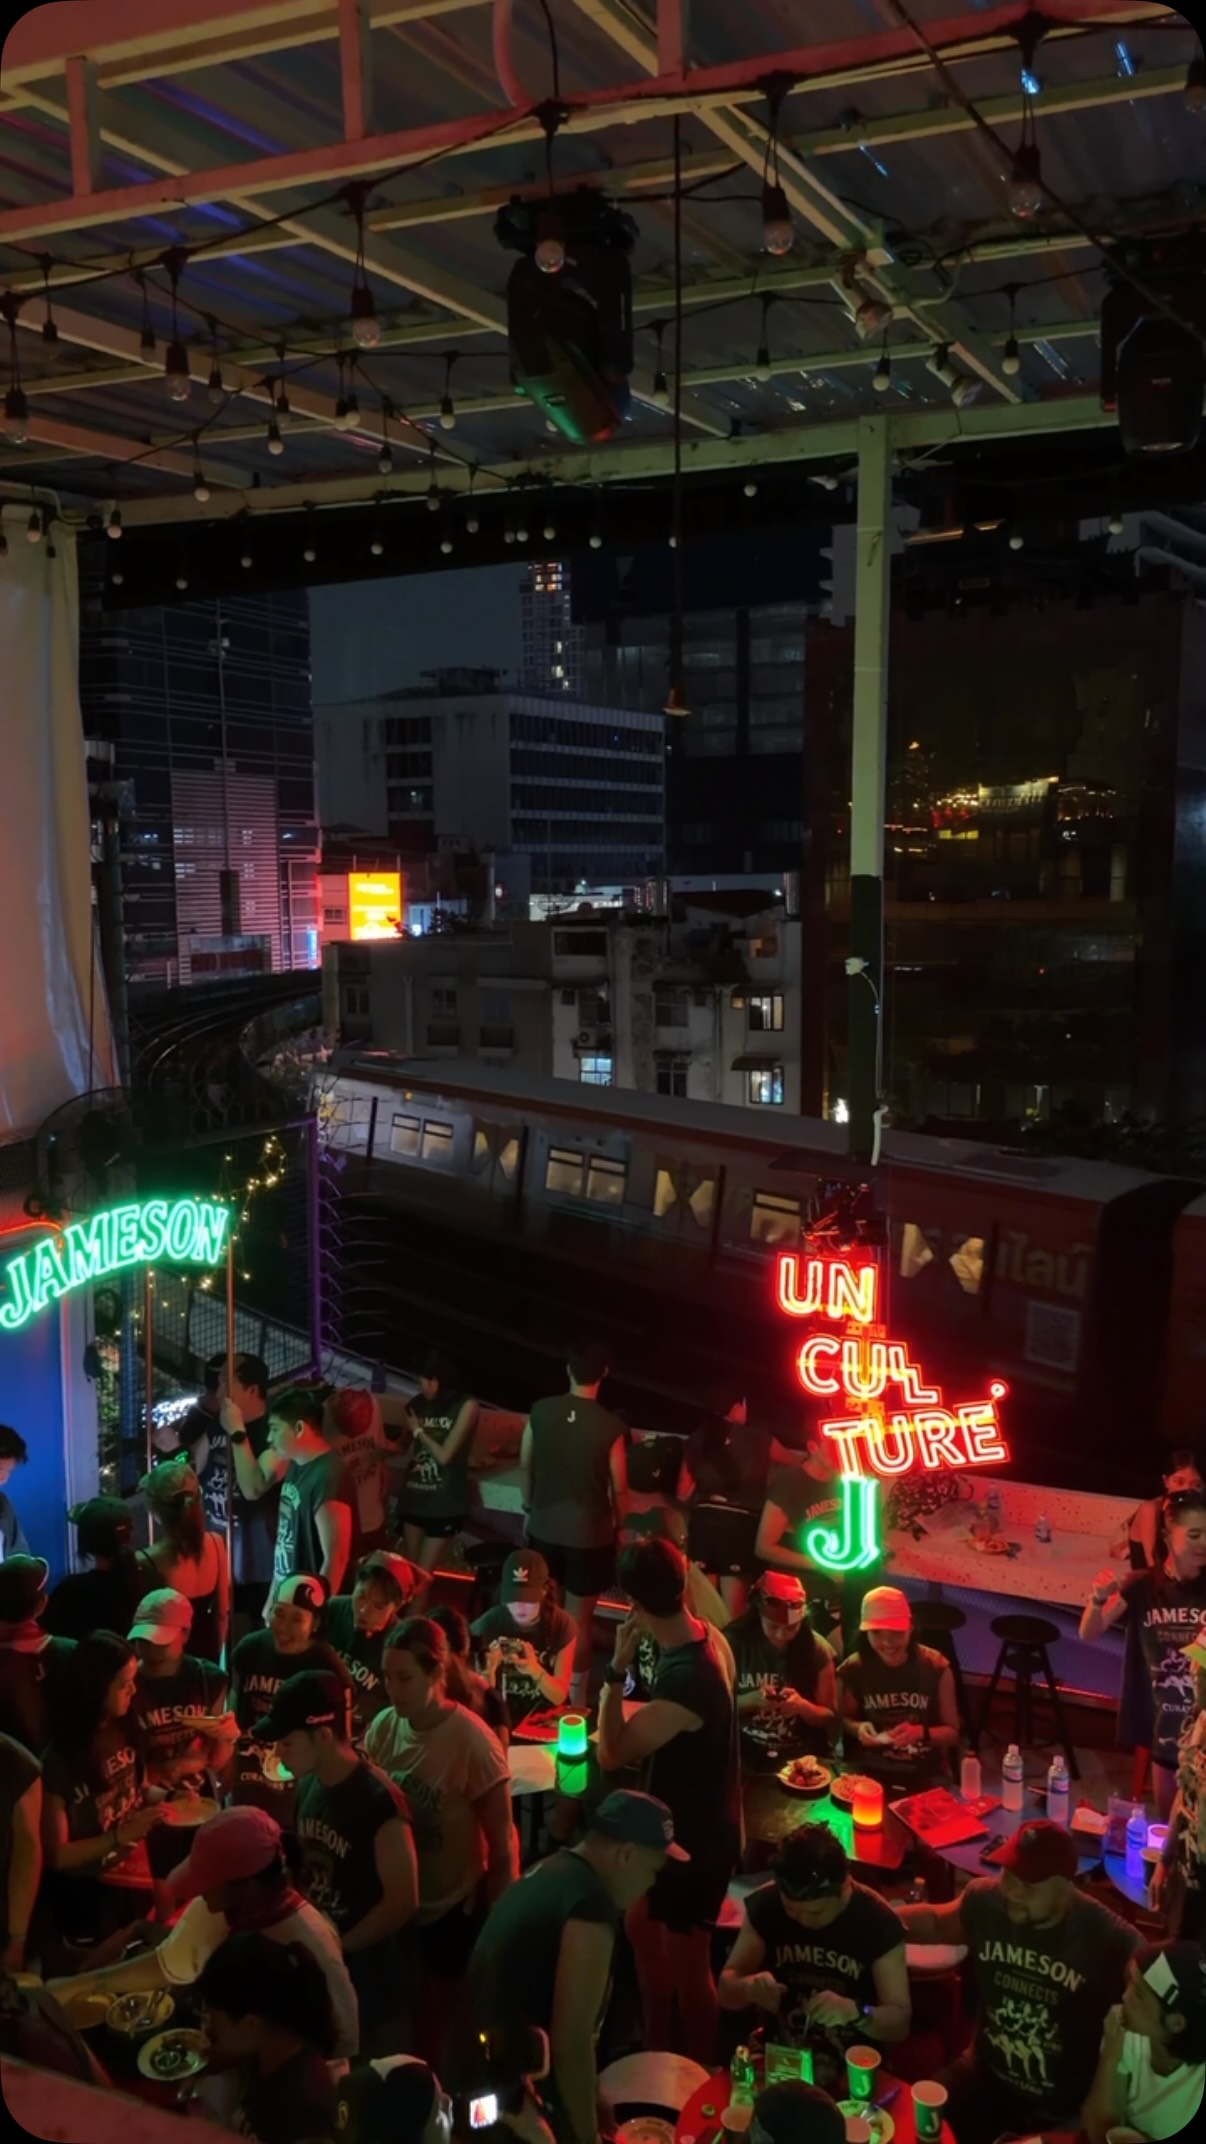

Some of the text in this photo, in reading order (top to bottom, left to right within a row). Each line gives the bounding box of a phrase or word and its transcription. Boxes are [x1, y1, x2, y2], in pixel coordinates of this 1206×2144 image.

[1, 1199, 229, 1329] JAMESON
[778, 1253, 876, 1323] UN
[807, 1475, 879, 1569] J
[738, 1672, 780, 1690] JAME
[863, 1693, 929, 1710] JAMESON
[774, 1943, 862, 1982] JAMESON
[978, 1940, 1082, 1993] JAMESON
[993, 1970, 1060, 2006] CONNECTS
[855, 2074, 871, 2096] J
[924, 2110, 939, 2133] J
